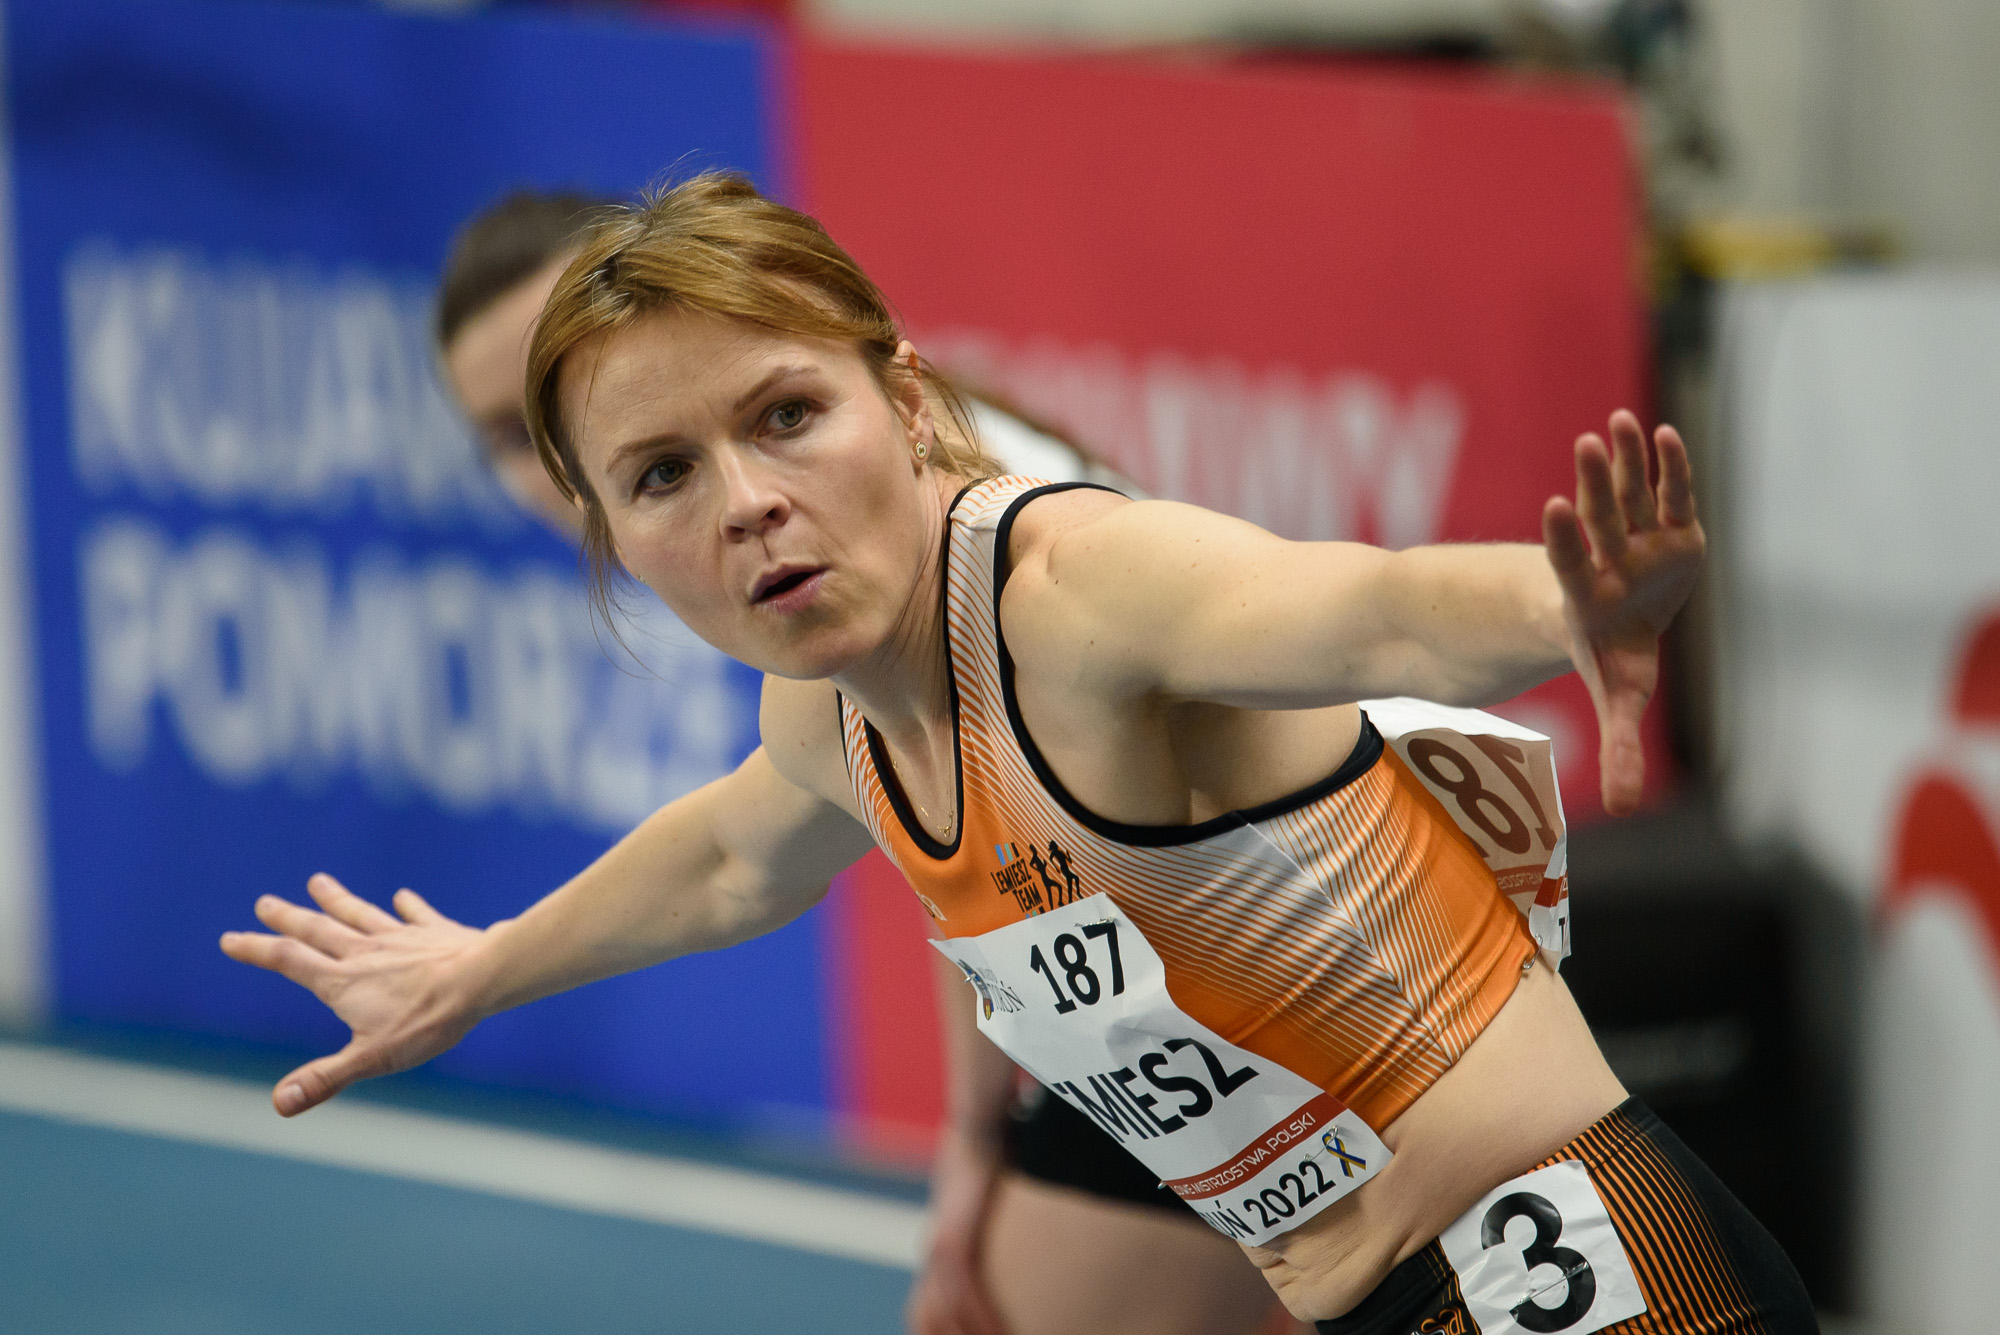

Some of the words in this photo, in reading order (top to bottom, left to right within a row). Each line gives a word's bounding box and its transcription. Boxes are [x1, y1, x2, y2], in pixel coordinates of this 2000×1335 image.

[990, 858, 1032, 895] LEMIESZ
[1012, 882, 1043, 913] TEAM
[1030, 921, 1125, 1015] 187
[1051, 1038, 1260, 1143] MIESZ
[1190, 1147, 1271, 1194] MISTRZOSTWA
[1266, 1112, 1317, 1151] POLSKI
[1243, 1161, 1337, 1229] 2022
[1481, 1192, 1597, 1333] 3
